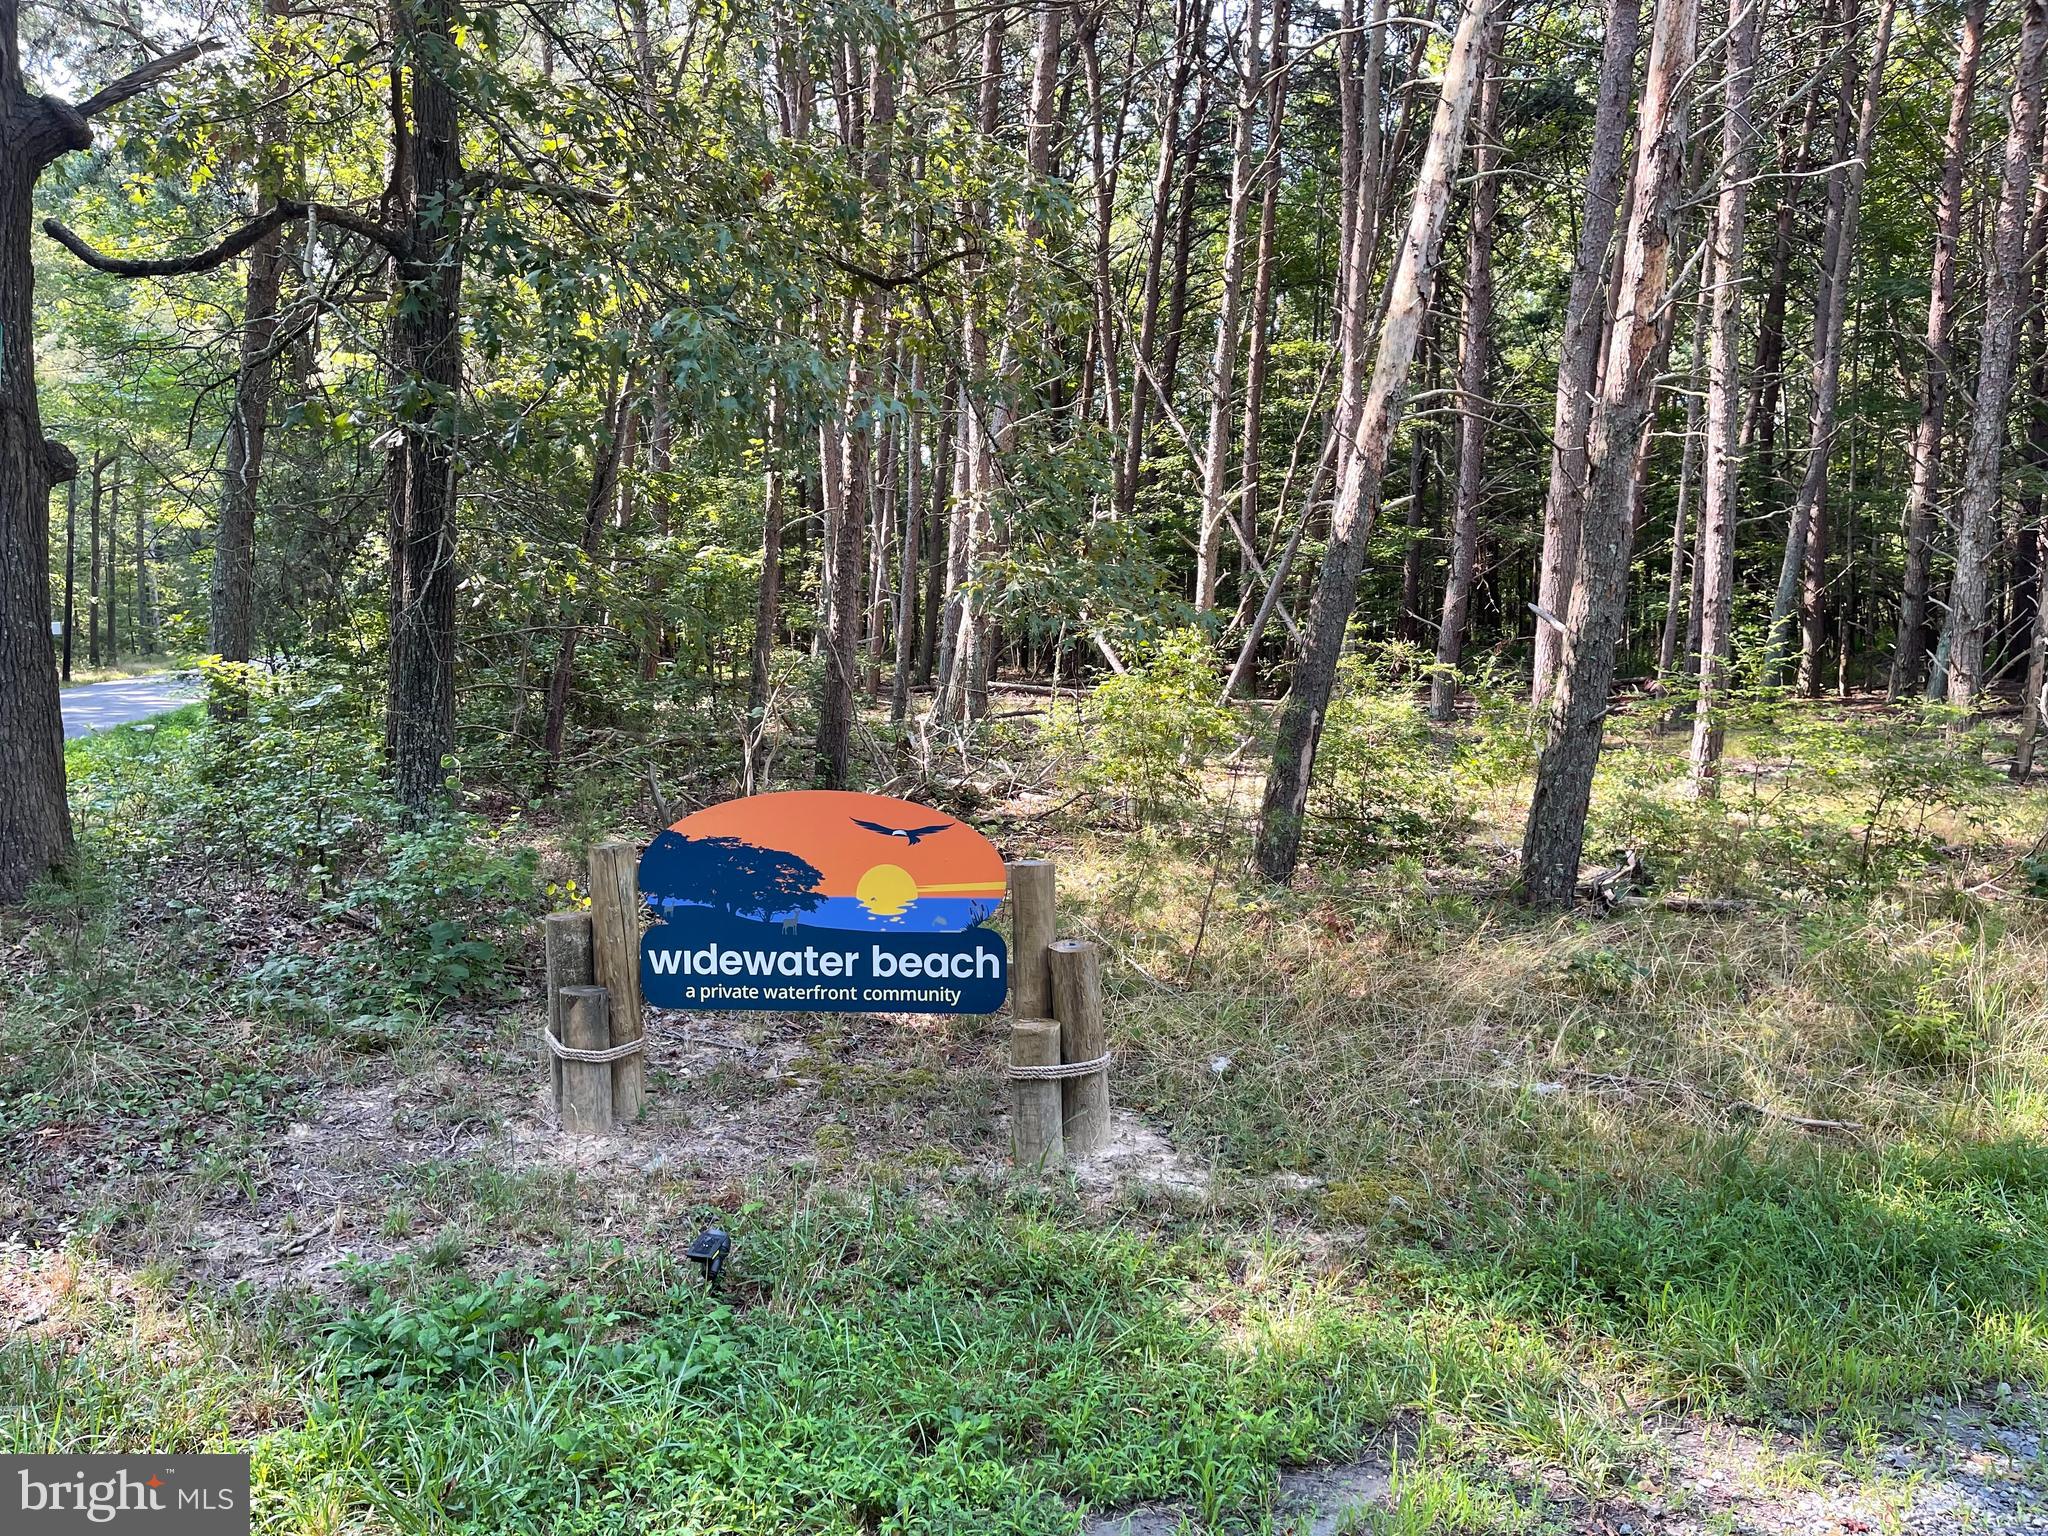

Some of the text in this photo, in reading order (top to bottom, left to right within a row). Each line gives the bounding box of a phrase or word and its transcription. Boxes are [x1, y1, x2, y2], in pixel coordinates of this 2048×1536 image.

[873, 945, 1000, 979] beach
[685, 984, 962, 1007] a private waterfront community
